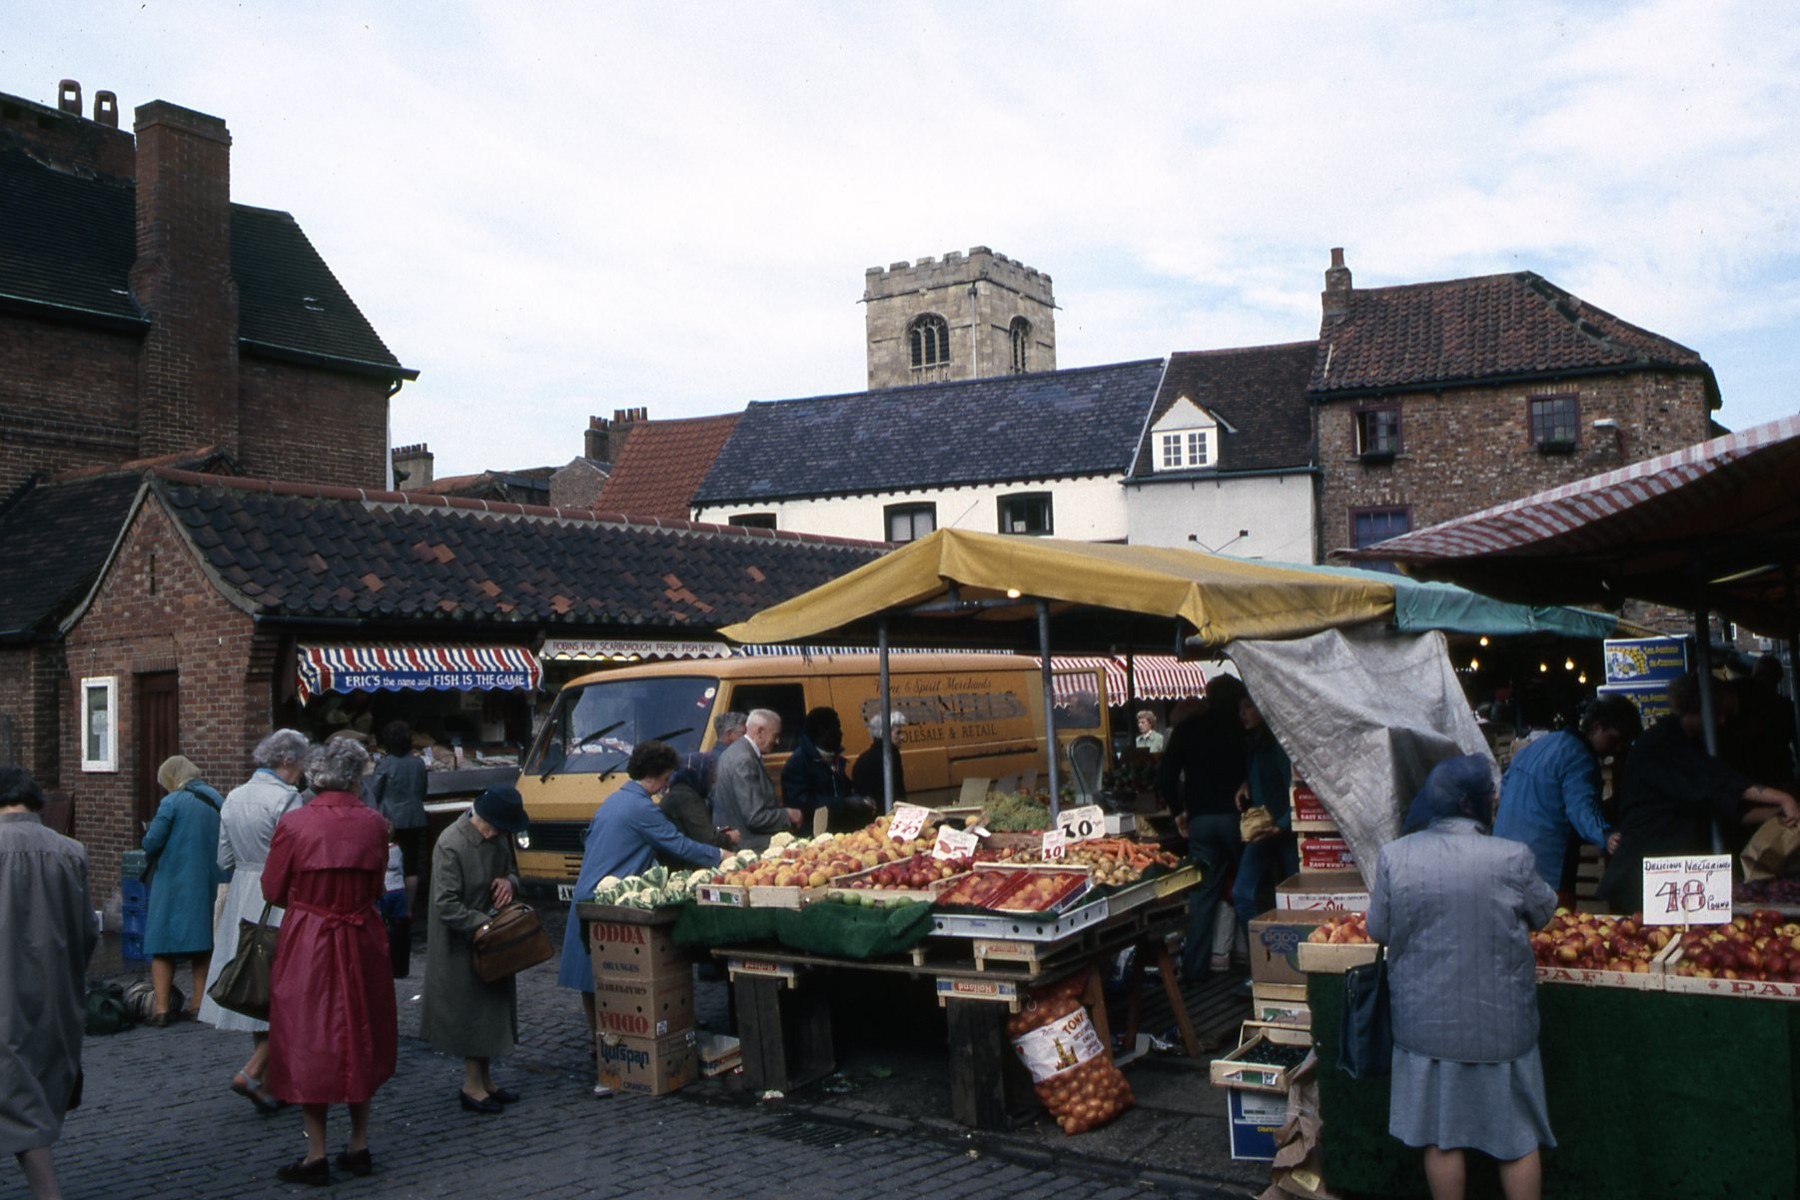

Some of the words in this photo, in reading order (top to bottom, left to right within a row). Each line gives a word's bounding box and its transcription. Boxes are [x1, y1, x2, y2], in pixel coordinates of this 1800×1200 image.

[553, 642, 579, 650] ROBINS
[582, 642, 596, 650] FOR
[600, 642, 651, 651] SCARBOROUGH
[656, 643, 678, 651] FRESH
[682, 643, 699, 651] FISH
[345, 674, 381, 687] ERIC'S
[383, 677, 395, 686] the
[418, 677, 431, 686] and
[433, 674, 459, 686] FISH
[463, 674, 472, 685] IS
[475, 674, 494, 685] THE
[496, 674, 525, 685] GAME
[946, 676, 992, 691] Merchants
[962, 723, 997, 737] RETAIL
[1655, 879, 1706, 913] 48
[593, 923, 646, 945] ODDA
[602, 961, 640, 973] ORANGES
[958, 981, 993, 993] Holland
[598, 1010, 650, 1035] ODDA
